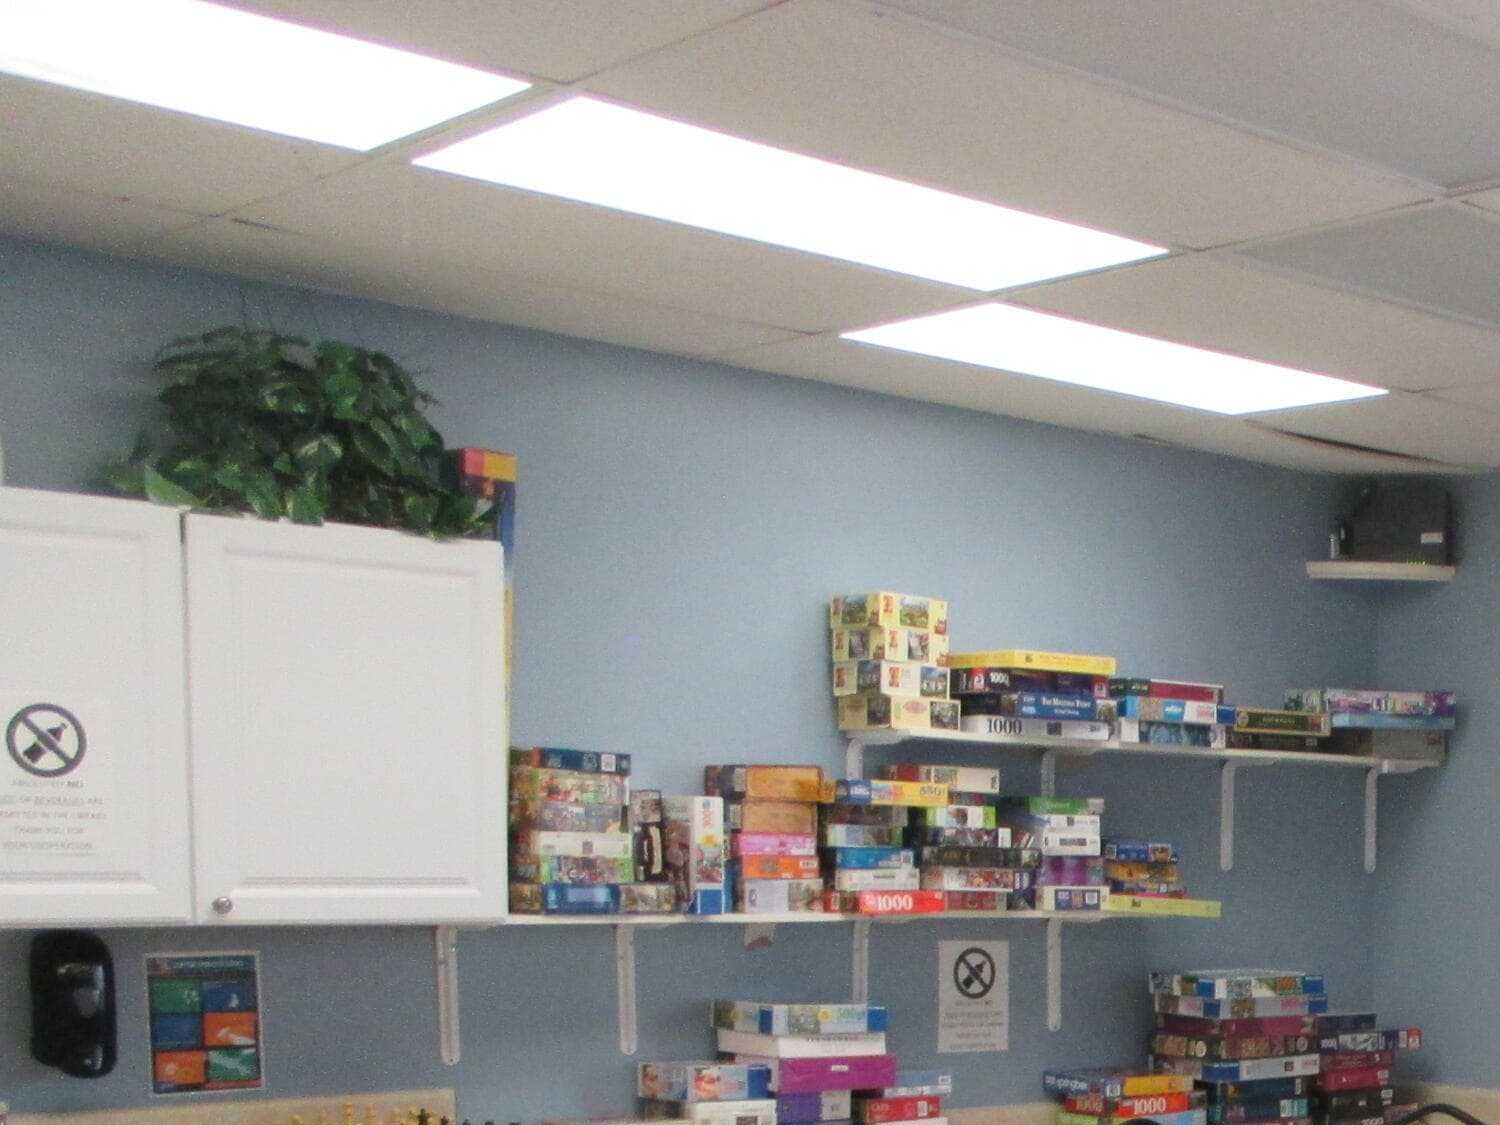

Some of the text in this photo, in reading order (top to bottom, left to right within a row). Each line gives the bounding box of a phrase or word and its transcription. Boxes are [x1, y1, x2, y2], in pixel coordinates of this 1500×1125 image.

[987, 718, 1022, 735] 1000
[877, 894, 913, 911] 1000
[1133, 1097, 1166, 1115] 1000
